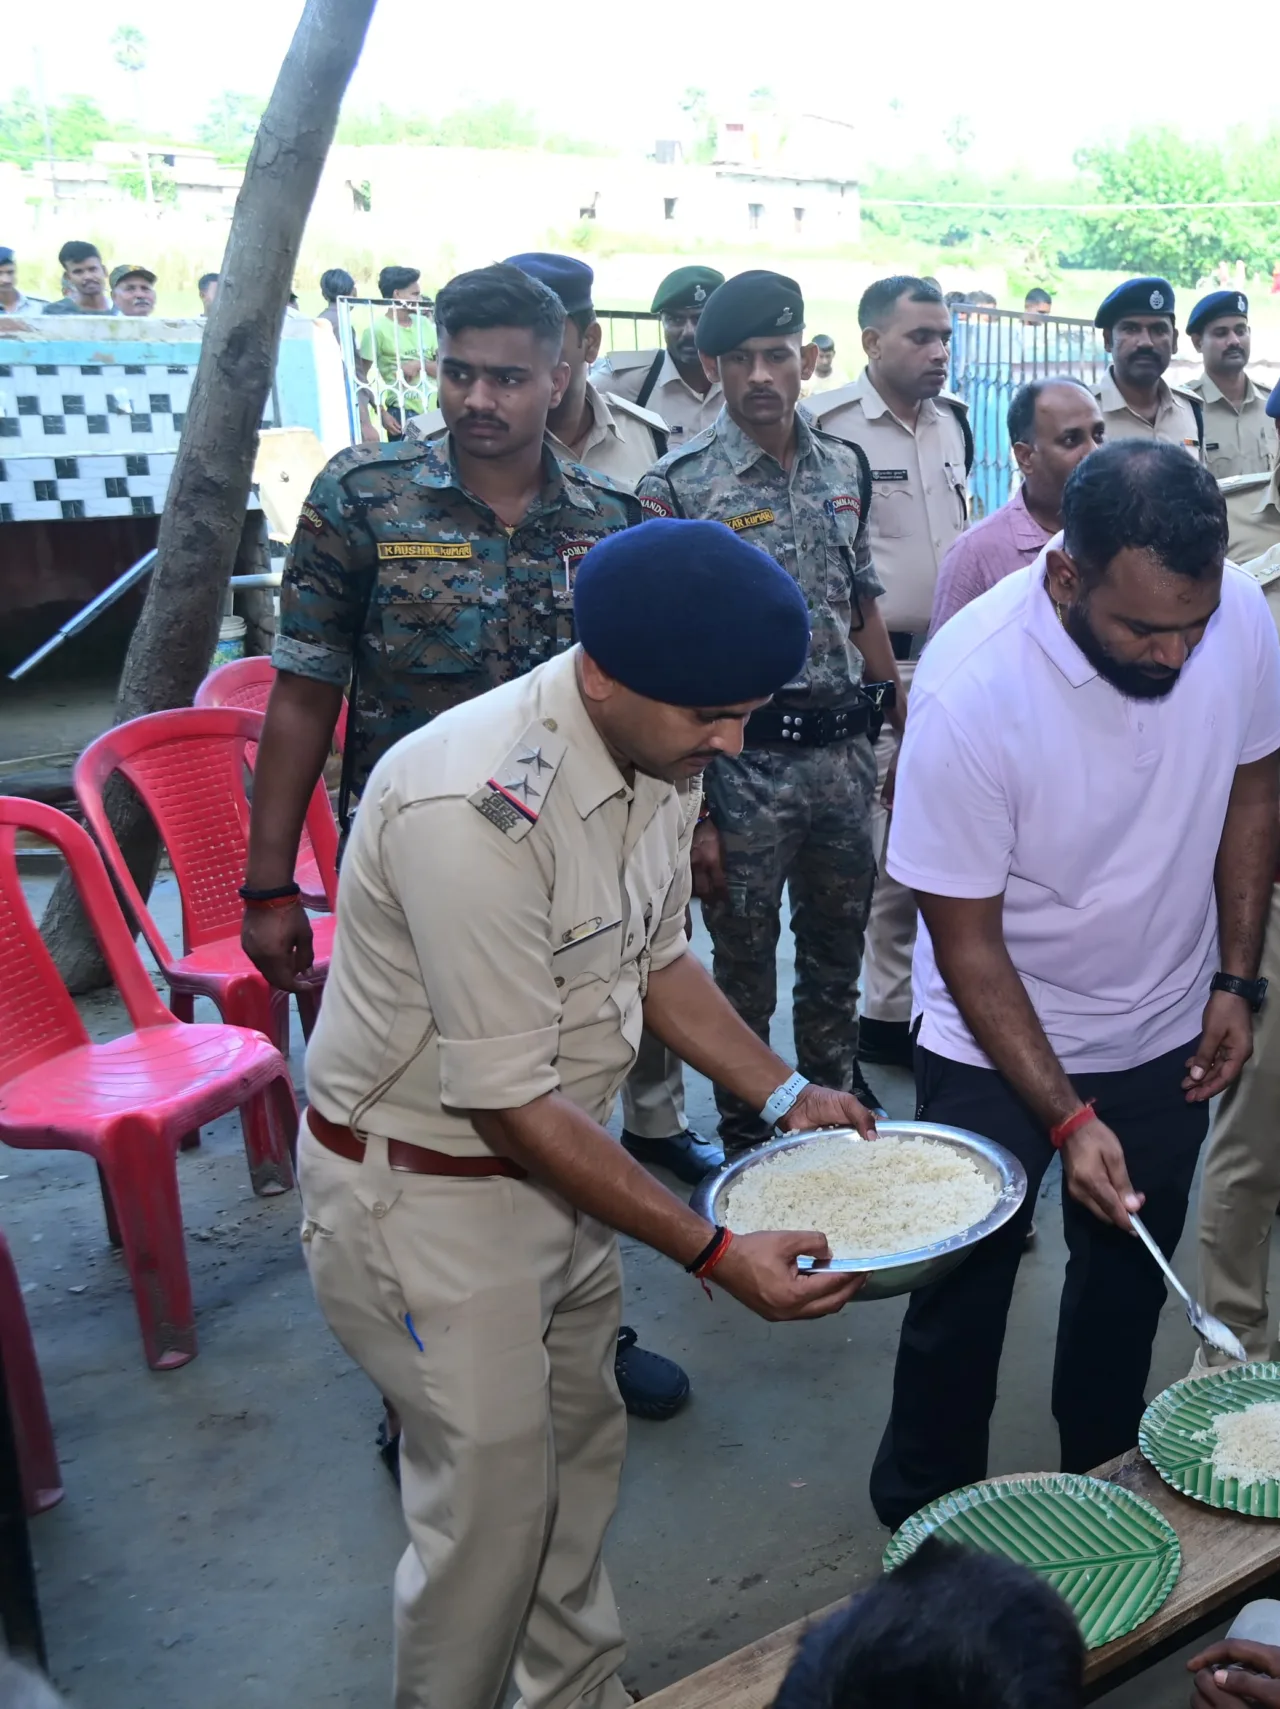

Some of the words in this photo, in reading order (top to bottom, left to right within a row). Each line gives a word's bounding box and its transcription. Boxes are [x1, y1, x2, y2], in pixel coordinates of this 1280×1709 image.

[744, 511, 772, 526] KUMAR
[384, 546, 439, 556] KAUSHAL
[440, 546, 470, 556] KUMAR
